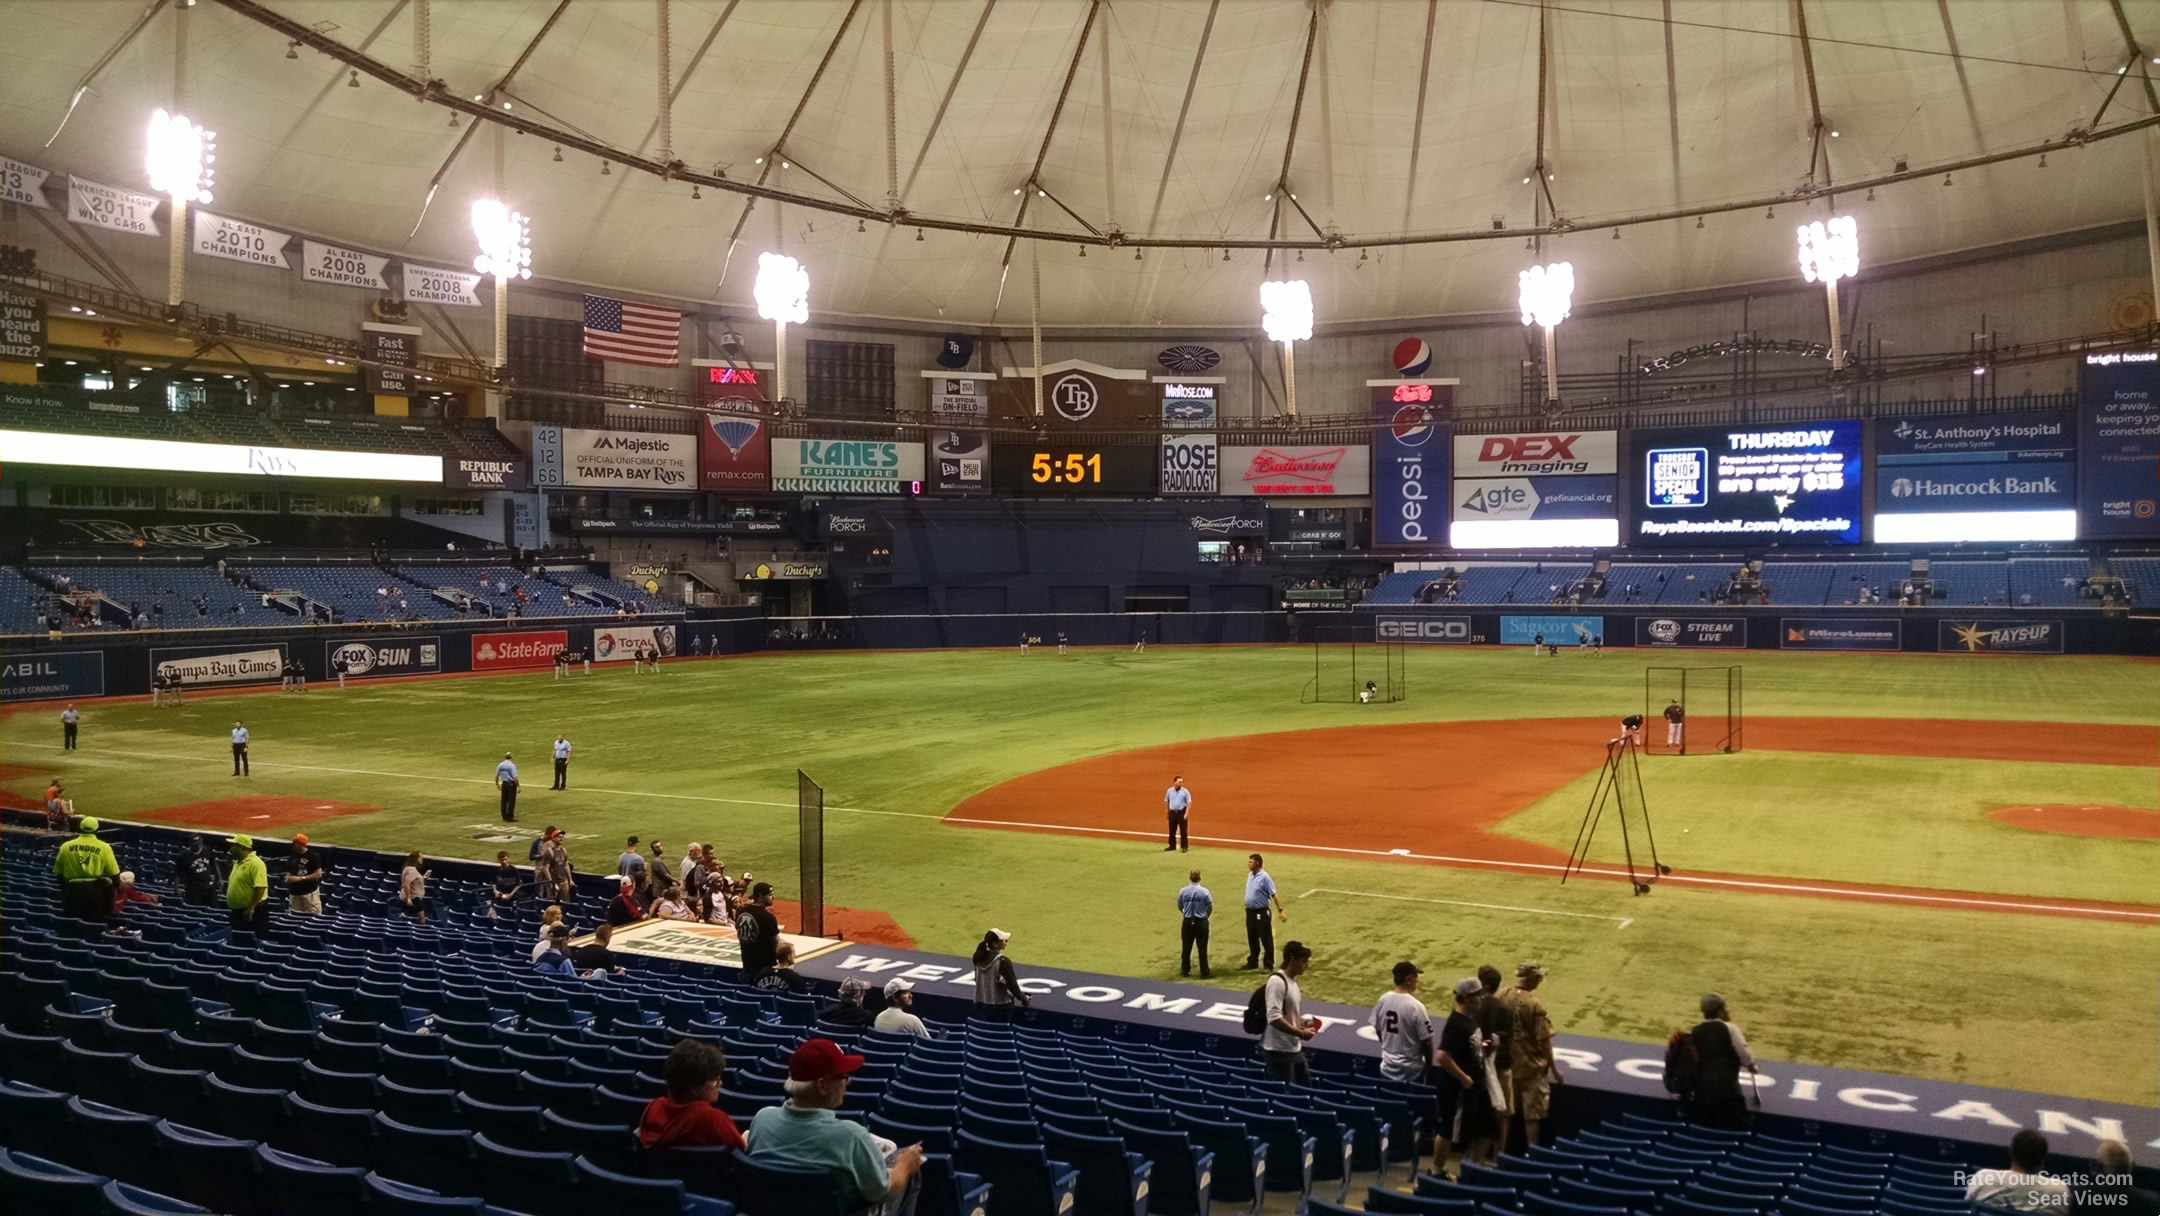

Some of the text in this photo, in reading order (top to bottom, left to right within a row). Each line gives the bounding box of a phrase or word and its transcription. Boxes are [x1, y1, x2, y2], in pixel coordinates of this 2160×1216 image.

[5, 161, 42, 178] LEAGUE
[71, 182, 153, 207] AMERICAN LEAGUE
[92, 197, 135, 219] 2011
[79, 208, 146, 232] WILD CARD
[221, 222, 262, 236] AL EAST
[216, 230, 265, 251] 2010
[201, 241, 277, 264] CHAMPIONS
[341, 251, 364, 261] EAST
[323, 256, 366, 276] 2008
[310, 268, 378, 287] CHAMPIONS
[409, 268, 444, 279] AMERICAN
[422, 278, 461, 294] 2008
[0, 291, 37, 307] Have
[409, 290, 472, 304] CHAMPIONS
[4, 306, 32, 320] you
[6, 331, 32, 344] the
[378, 336, 404, 350] Fast
[949, 341, 960, 354] TB
[1639, 338, 1778, 376] TROPICANA
[2086, 352, 2158, 366] bright house
[382, 370, 404, 380] can
[381, 380, 406, 390] use.
[6, 395, 64, 408] Know it now.
[1061, 384, 1090, 411] TB
[2114, 390, 2148, 400] home
[89, 401, 140, 414] tampabay.com
[943, 403, 978, 412] ON-FIELD
[2105, 402, 2157, 413] or away...
[2096, 414, 2142, 426] keeping
[538, 430, 557, 444] 42
[1914, 423, 2061, 440] St. Anthony's Hospital
[2099, 424, 2160, 436] connected
[616, 437, 670, 454] Majestic
[950, 432, 960, 446] TB
[1728, 430, 1834, 450] THURSDAY
[1914, 440, 1995, 451] BayCare Health System
[800, 441, 898, 467] KANE'S
[1478, 435, 1582, 462] DEX
[541, 449, 555, 464] 12
[577, 455, 684, 468] OFFICIAL UNIFORM OF THE
[1164, 444, 1216, 470] ROSE
[460, 460, 514, 473] REPUBLIC
[1032, 454, 1100, 482] 5:51
[1252, 456, 1336, 472] Budweiser
[1500, 460, 1588, 474] imaging
[1660, 464, 1694, 477] SENIOR
[471, 471, 504, 483] BANK
[538, 468, 557, 483] 66
[577, 466, 623, 479] TAMPA
[626, 468, 652, 480] BAY
[707, 471, 764, 480] remax.com
[804, 468, 893, 477] FURNITURE
[1164, 470, 1216, 491] RADIOLOGY
[1756, 475, 1800, 494] only
[1803, 472, 1844, 492] $15
[1915, 477, 2058, 496] Hancock Bank
[1655, 480, 1699, 496] SPECIAL
[1397, 457, 1428, 541] pepsi
[1488, 486, 1526, 508] gte
[1544, 493, 1612, 504] gtefinancial.org
[2104, 502, 2130, 510] bright
[590, 520, 616, 528] Ballpark
[756, 522, 780, 530] Ballpark
[830, 523, 866, 532] PORCH
[1193, 518, 1232, 529] Budweiser
[1232, 520, 1263, 528] PORCH
[1641, 518, 1851, 536] RaysBaseball.com/Specials
[630, 564, 668, 578] Ducky's
[784, 564, 822, 578] Ducky's
[1379, 622, 1468, 638] GEICO
[1510, 619, 1568, 638] Sagicor
[1688, 624, 1734, 632] STREAM
[618, 638, 654, 648] TOTAL
[342, 650, 367, 662] FOX
[378, 648, 411, 666] SUN
[569, 653, 580, 661] 370
[211, 662, 237, 677] Bay
[238, 659, 276, 674] Times
[27, 684, 70, 694] COMMUNITY
[69, 844, 101, 856] VENDOR
[641, 928, 740, 950] Tropica
[1386, 1010, 1398, 1034] 2
